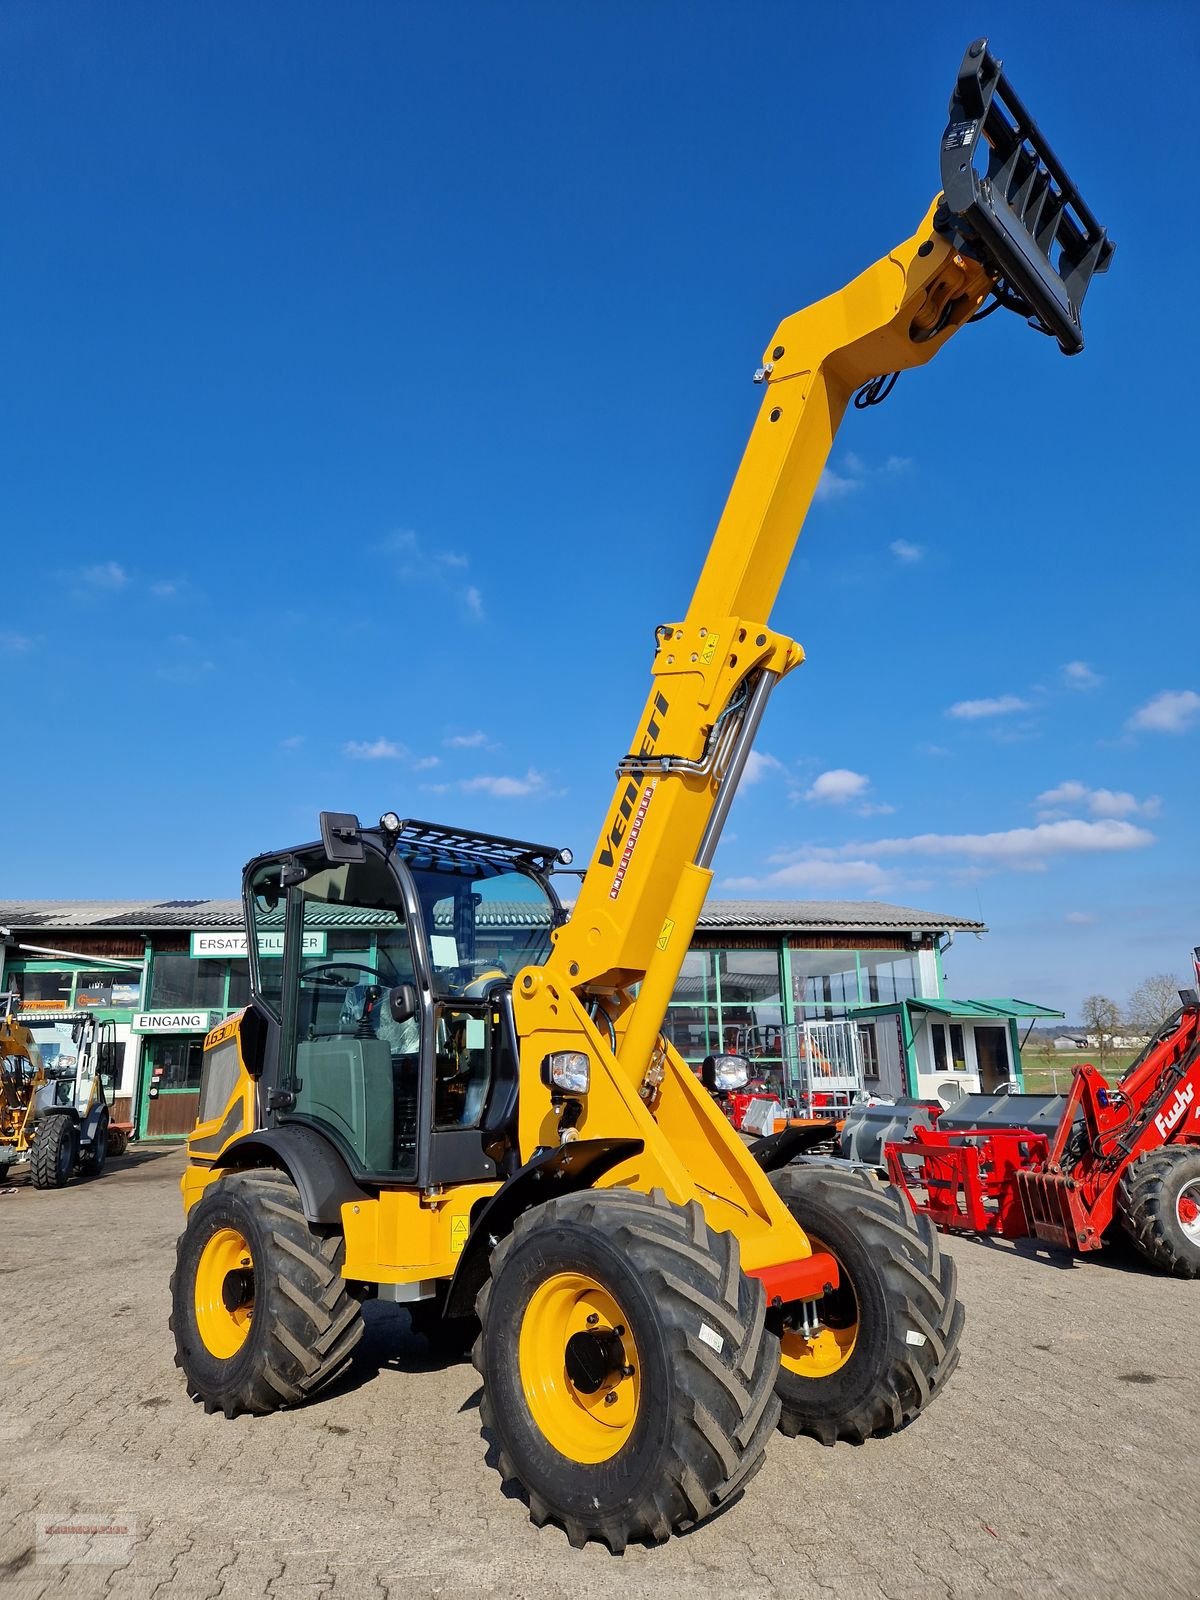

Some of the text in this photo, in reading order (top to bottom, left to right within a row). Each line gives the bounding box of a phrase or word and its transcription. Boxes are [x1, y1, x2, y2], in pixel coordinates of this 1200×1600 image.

[609, 786, 654, 900] AMSELGRUBER
[199, 938, 318, 949] ERSATZEILLER
[139, 1015, 201, 1027] EINGANG
[1154, 1082, 1194, 1139] Fuchs
